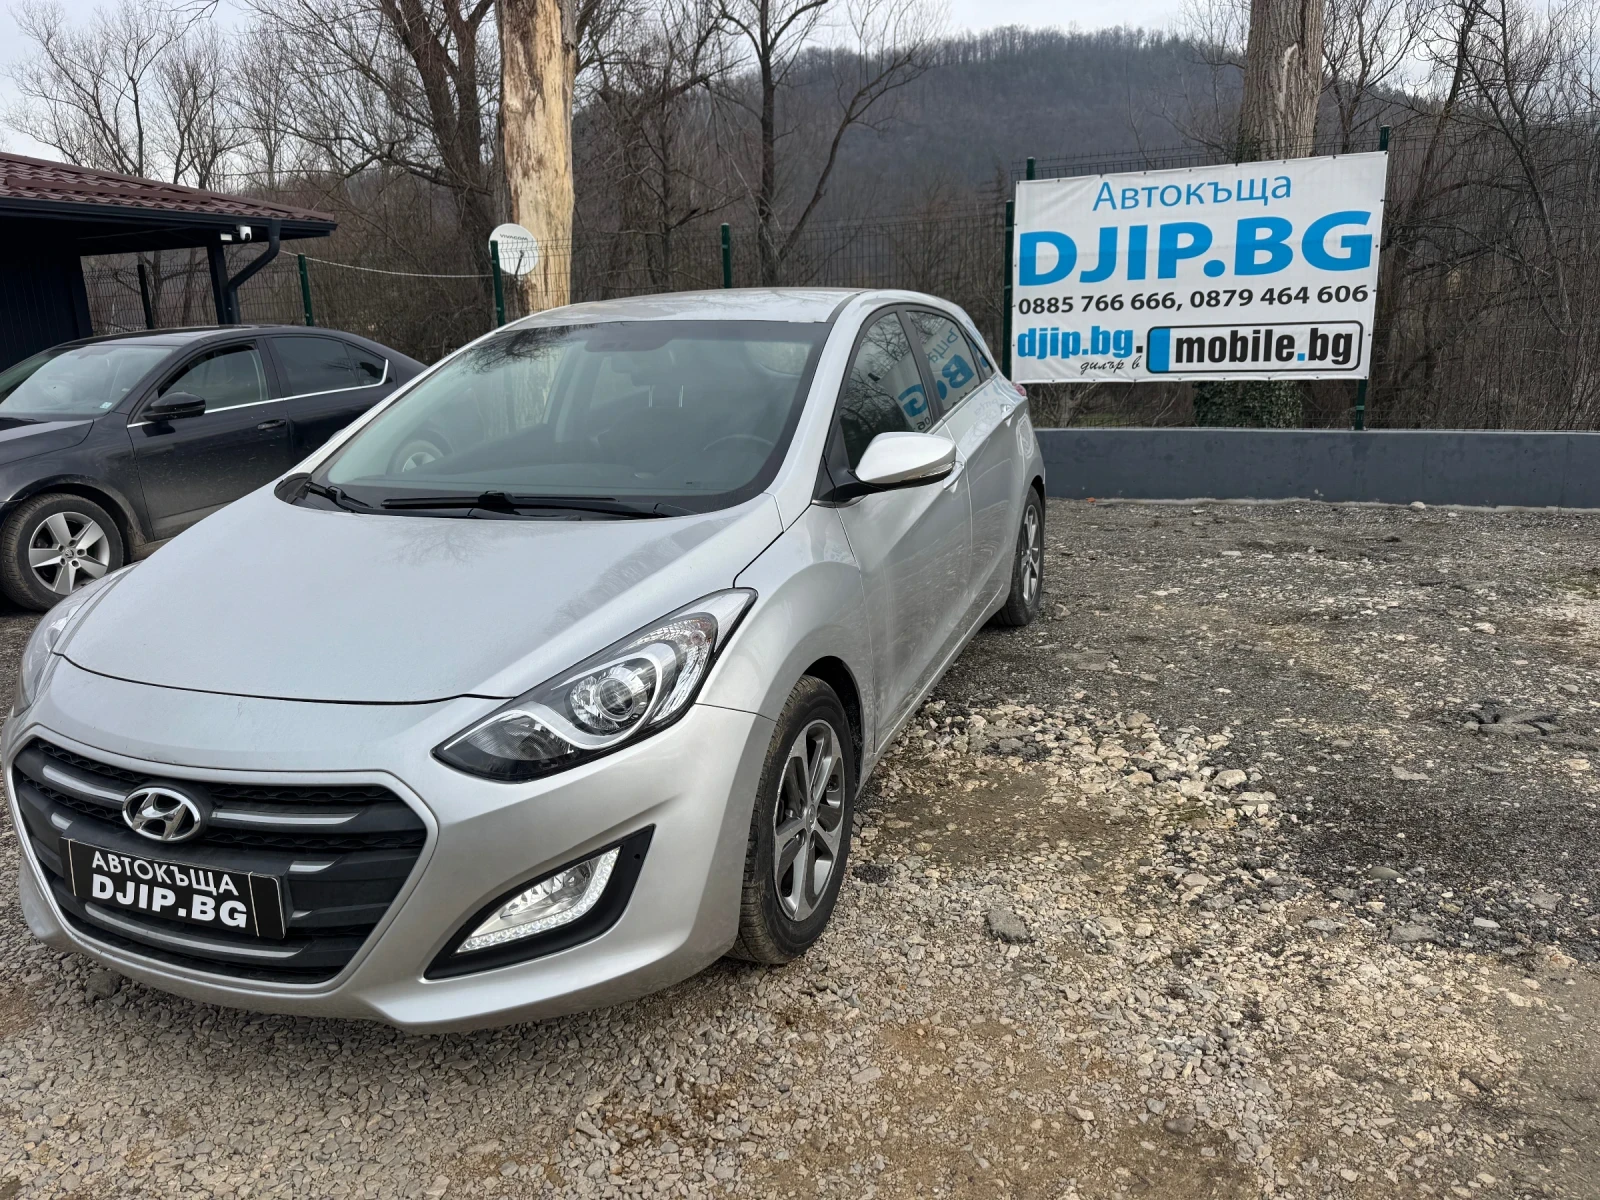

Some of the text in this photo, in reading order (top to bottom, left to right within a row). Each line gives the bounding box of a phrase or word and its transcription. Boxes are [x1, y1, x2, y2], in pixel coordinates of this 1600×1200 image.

[1093, 175, 1292, 212] Автокъща
[1018, 210, 1373, 287] DJIP.BG
[1018, 284, 1369, 315] 0885 766 666, 0879 464 606
[1175, 327, 1354, 365] mobile.bg
[1080, 360, 1125, 376] дилър
[91, 850, 239, 896] АВТОКЪЩА
[92, 873, 247, 928] DJIP.BG
